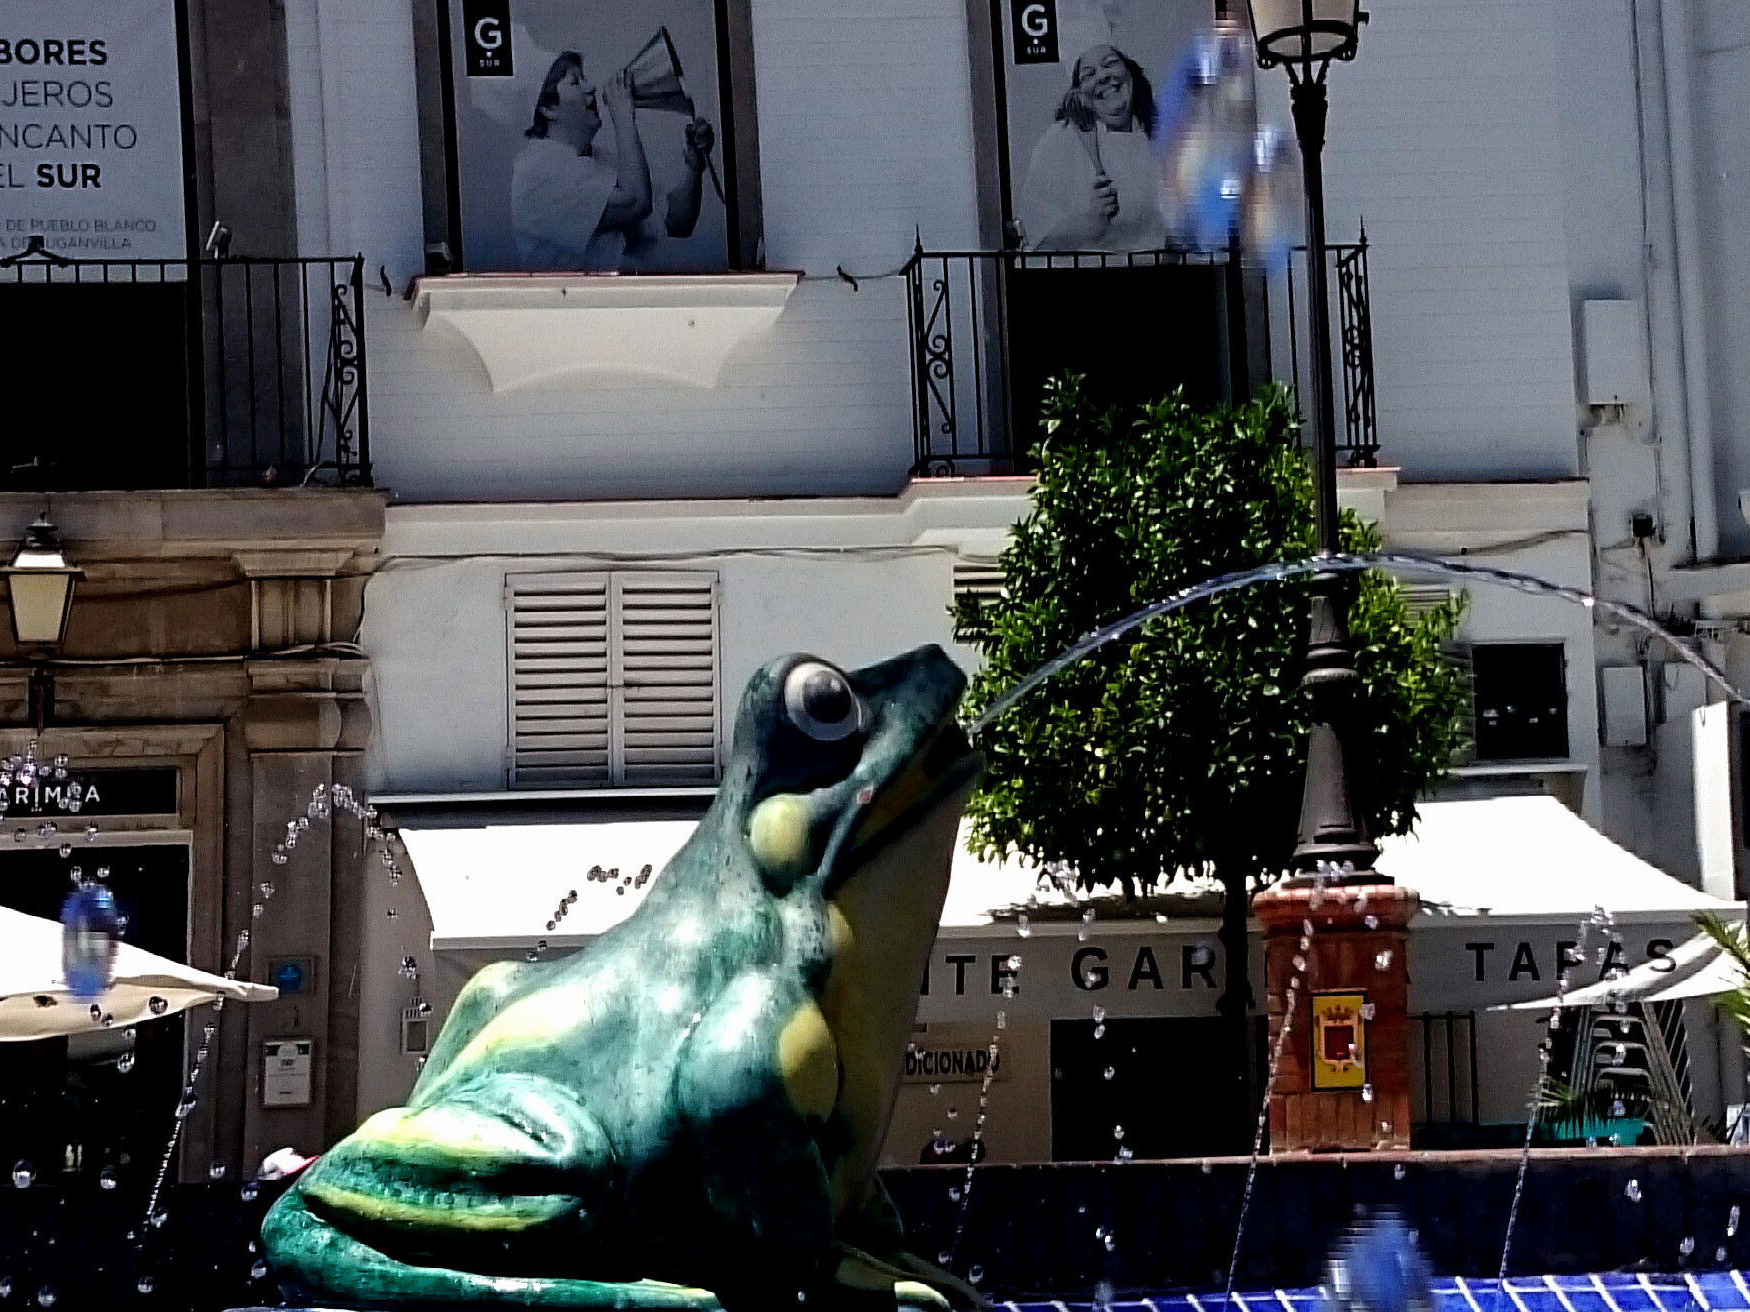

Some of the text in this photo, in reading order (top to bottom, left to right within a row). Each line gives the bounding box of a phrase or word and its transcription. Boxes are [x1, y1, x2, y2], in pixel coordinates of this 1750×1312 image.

[474, 16, 502, 49] G
[1021, 4, 1048, 37] G
[37, 163, 101, 189] SUR
[6, 219, 23, 233] DE
[30, 219, 90, 233] PUEBLO
[94, 220, 157, 234] BLANCO
[39, 237, 132, 250] UGANVILLA
[1465, 938, 1678, 982] TAPAS
